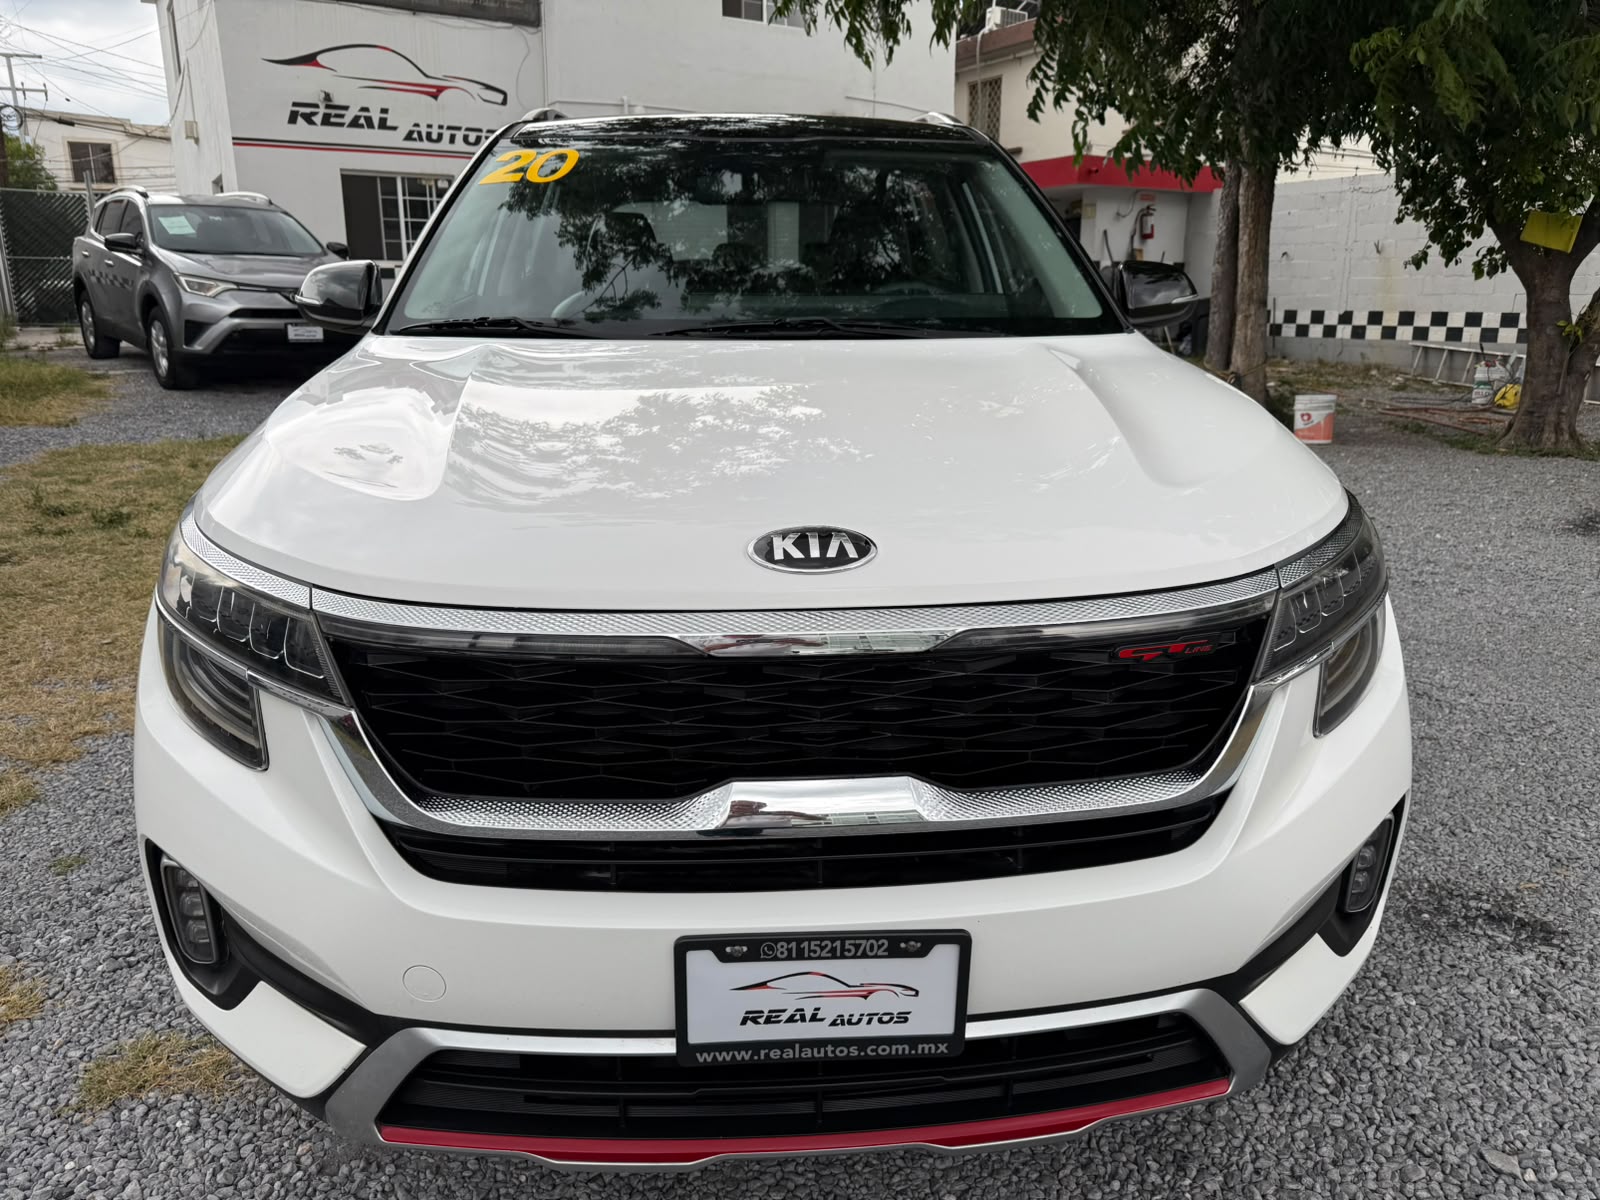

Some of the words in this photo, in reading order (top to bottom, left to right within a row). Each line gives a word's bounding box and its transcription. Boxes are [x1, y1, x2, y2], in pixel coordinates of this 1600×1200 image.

[287, 101, 399, 131] REAL
[478, 149, 580, 185] 20
[771, 532, 859, 560] KIA
[1119, 640, 1209, 661] GT
[740, 1007, 825, 1026] REAL
[828, 1011, 912, 1027] AUTOS
[695, 1042, 949, 1063] www.realautos.com.mx
